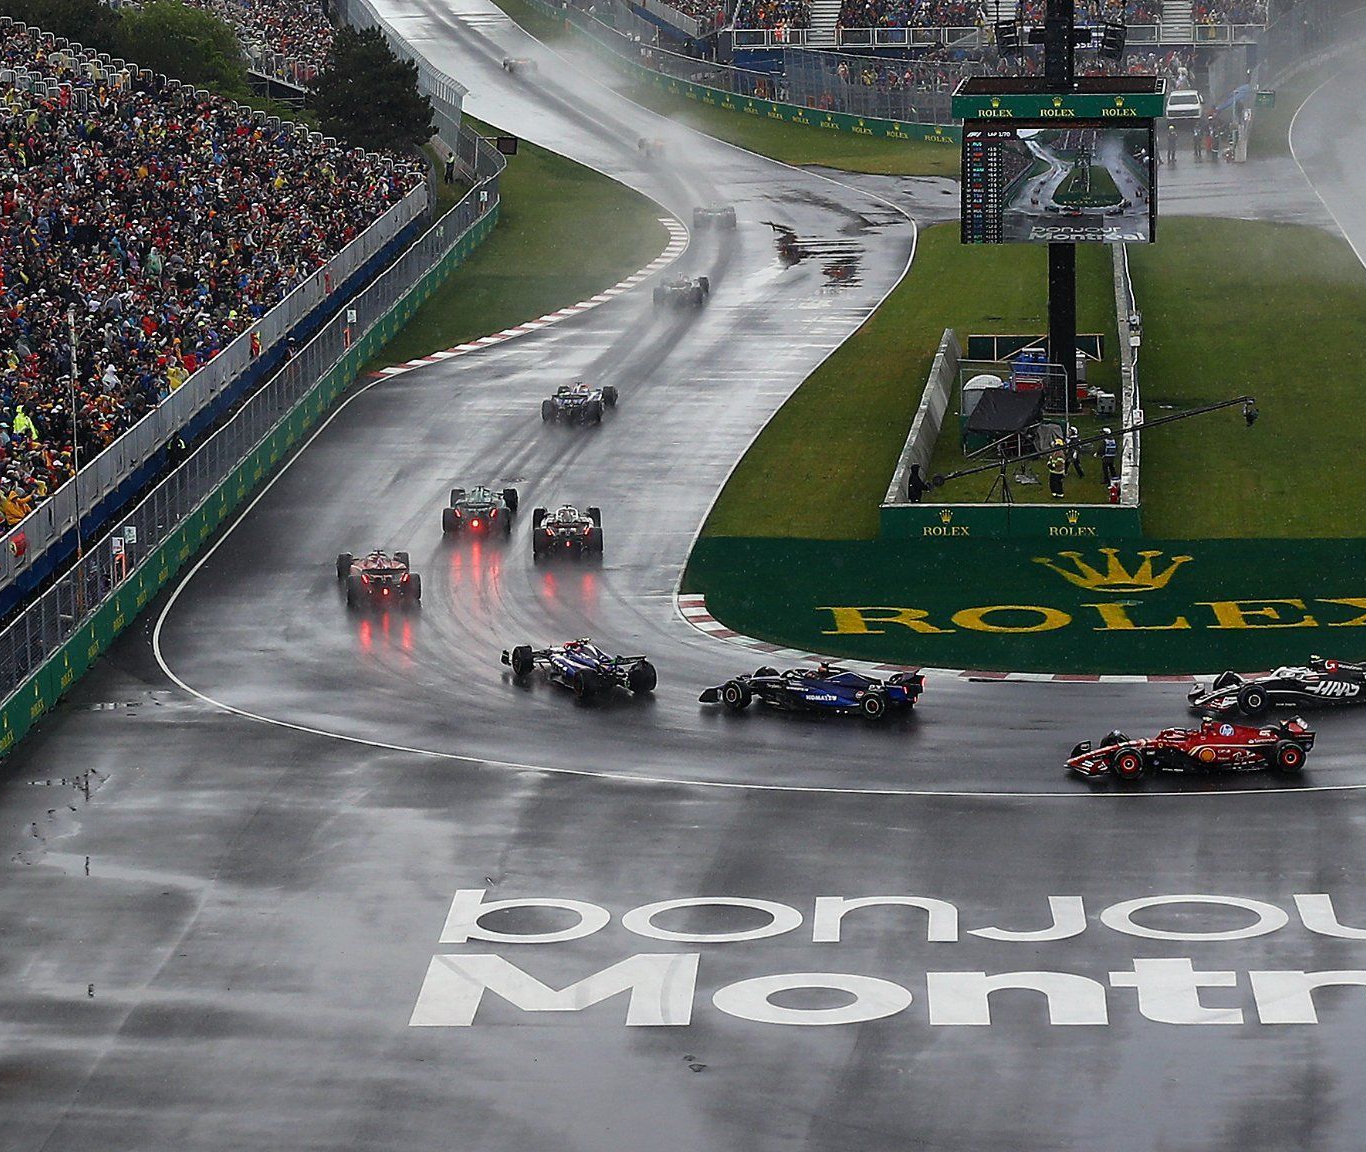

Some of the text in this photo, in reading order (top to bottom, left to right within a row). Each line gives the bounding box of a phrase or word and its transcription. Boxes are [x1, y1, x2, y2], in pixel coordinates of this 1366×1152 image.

[978, 109, 1013, 118] ROLEX
[1040, 109, 1075, 117] ROLEX
[1102, 108, 1137, 117] ROLEX
[851, 126, 873, 135] ROLEX
[886, 130, 909, 139] ROLEX
[923, 134, 954, 144] ROLEX
[923, 526, 970, 536] ROLEX
[1049, 526, 1097, 537] ROLEX
[1313, 680, 1360, 696] HAAS
